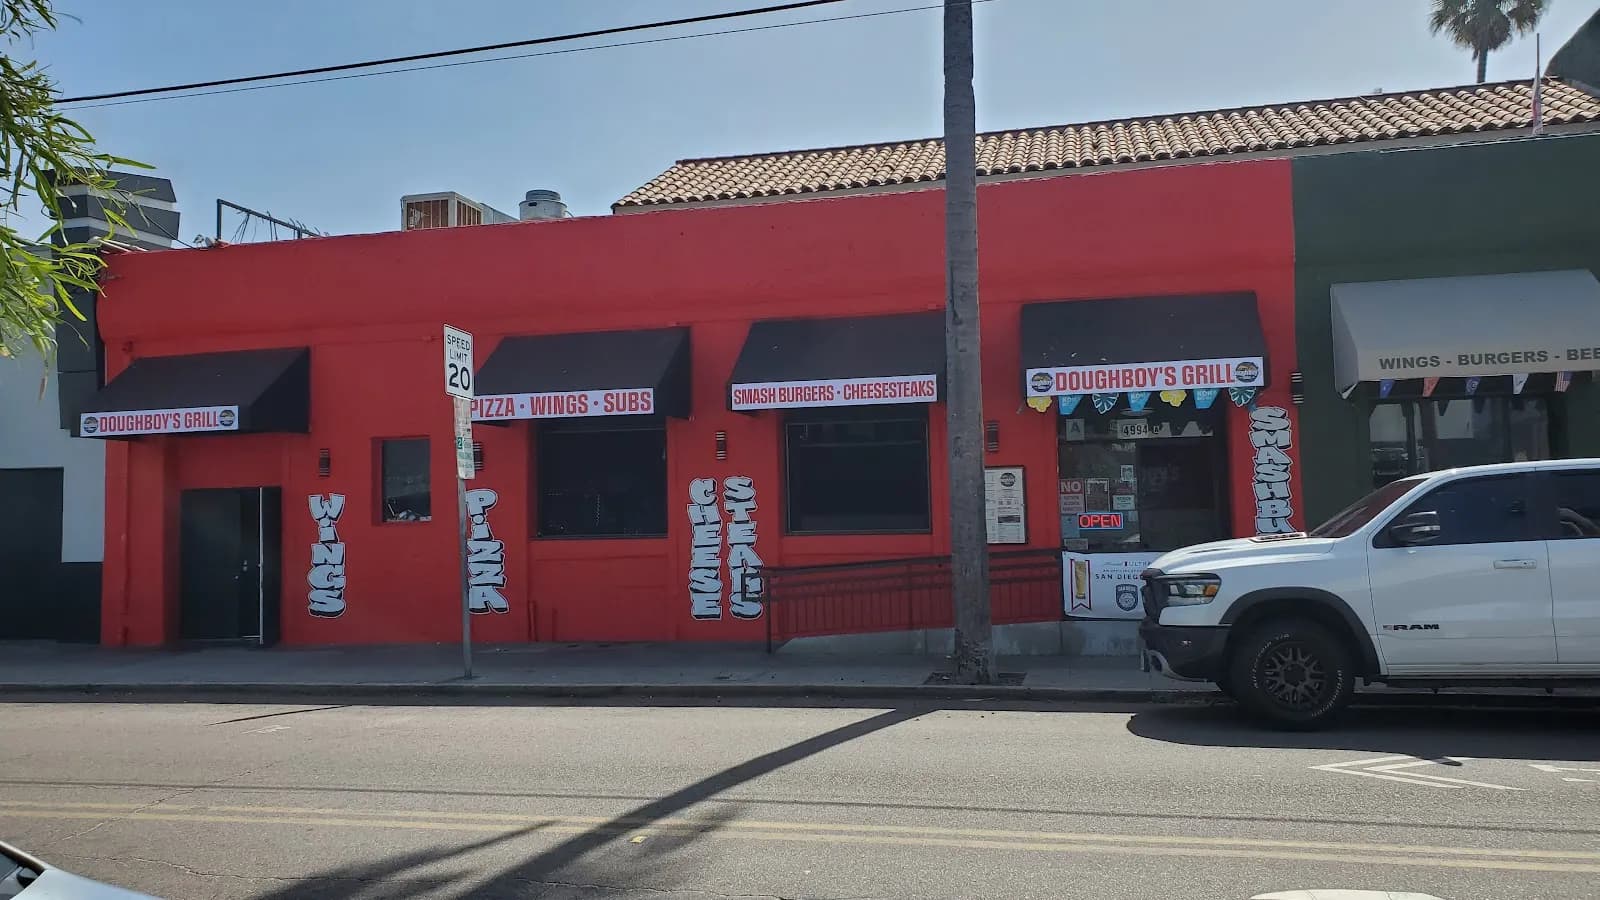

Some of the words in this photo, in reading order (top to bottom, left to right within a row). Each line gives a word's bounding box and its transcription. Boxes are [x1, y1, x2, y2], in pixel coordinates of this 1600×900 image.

[447, 334, 470, 350] SPEED
[449, 348, 468, 362] LIMIT
[1379, 356, 1440, 369] WINGS
[1458, 350, 1549, 366] BURGERS
[448, 363, 470, 391] 20
[1055, 366, 1177, 392] DOUGHBOY'S
[1182, 364, 1235, 386] GRILL
[530, 393, 588, 416] WINGS
[603, 391, 651, 413] SUBS
[733, 388, 775, 405] SMASH
[778, 384, 834, 403] BURGERS
[843, 380, 935, 401] CHEESESTEAKS
[100, 412, 181, 433] DOUGHBOY'S
[184, 410, 219, 430] GRILL
[1123, 424, 1148, 436] 4994
[1061, 481, 1082, 493] NO
[1079, 514, 1121, 528] OPEN
[307, 492, 346, 618] WINGS
[465, 488, 510, 614] PIZZA
[687, 477, 723, 620] CHEESE
